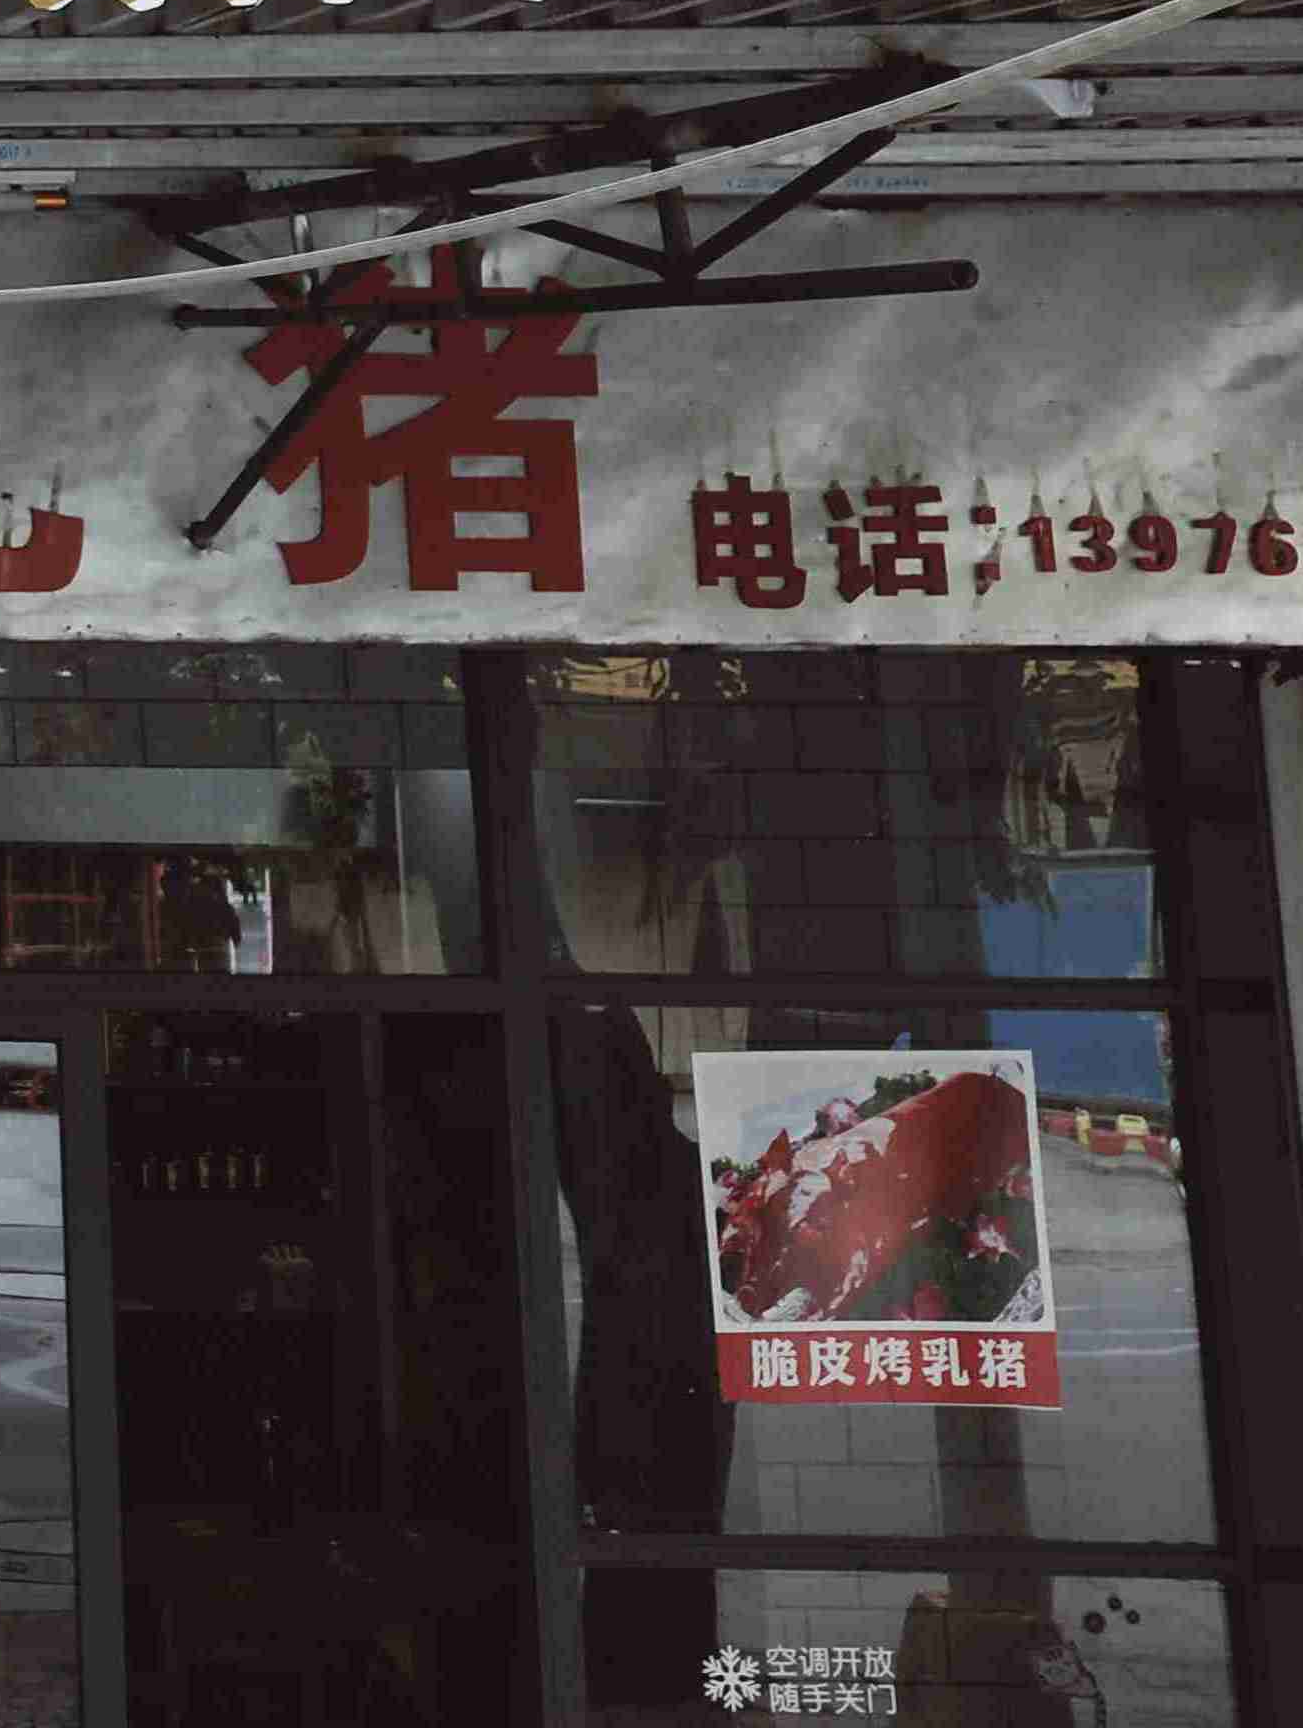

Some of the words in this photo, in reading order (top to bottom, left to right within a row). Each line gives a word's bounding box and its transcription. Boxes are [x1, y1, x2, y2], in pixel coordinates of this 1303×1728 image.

[750, 1336, 1028, 1390] 脆皮烤乳猪
[765, 1646, 897, 1680] 空调开放
[768, 1682, 898, 1716] 随手关门
